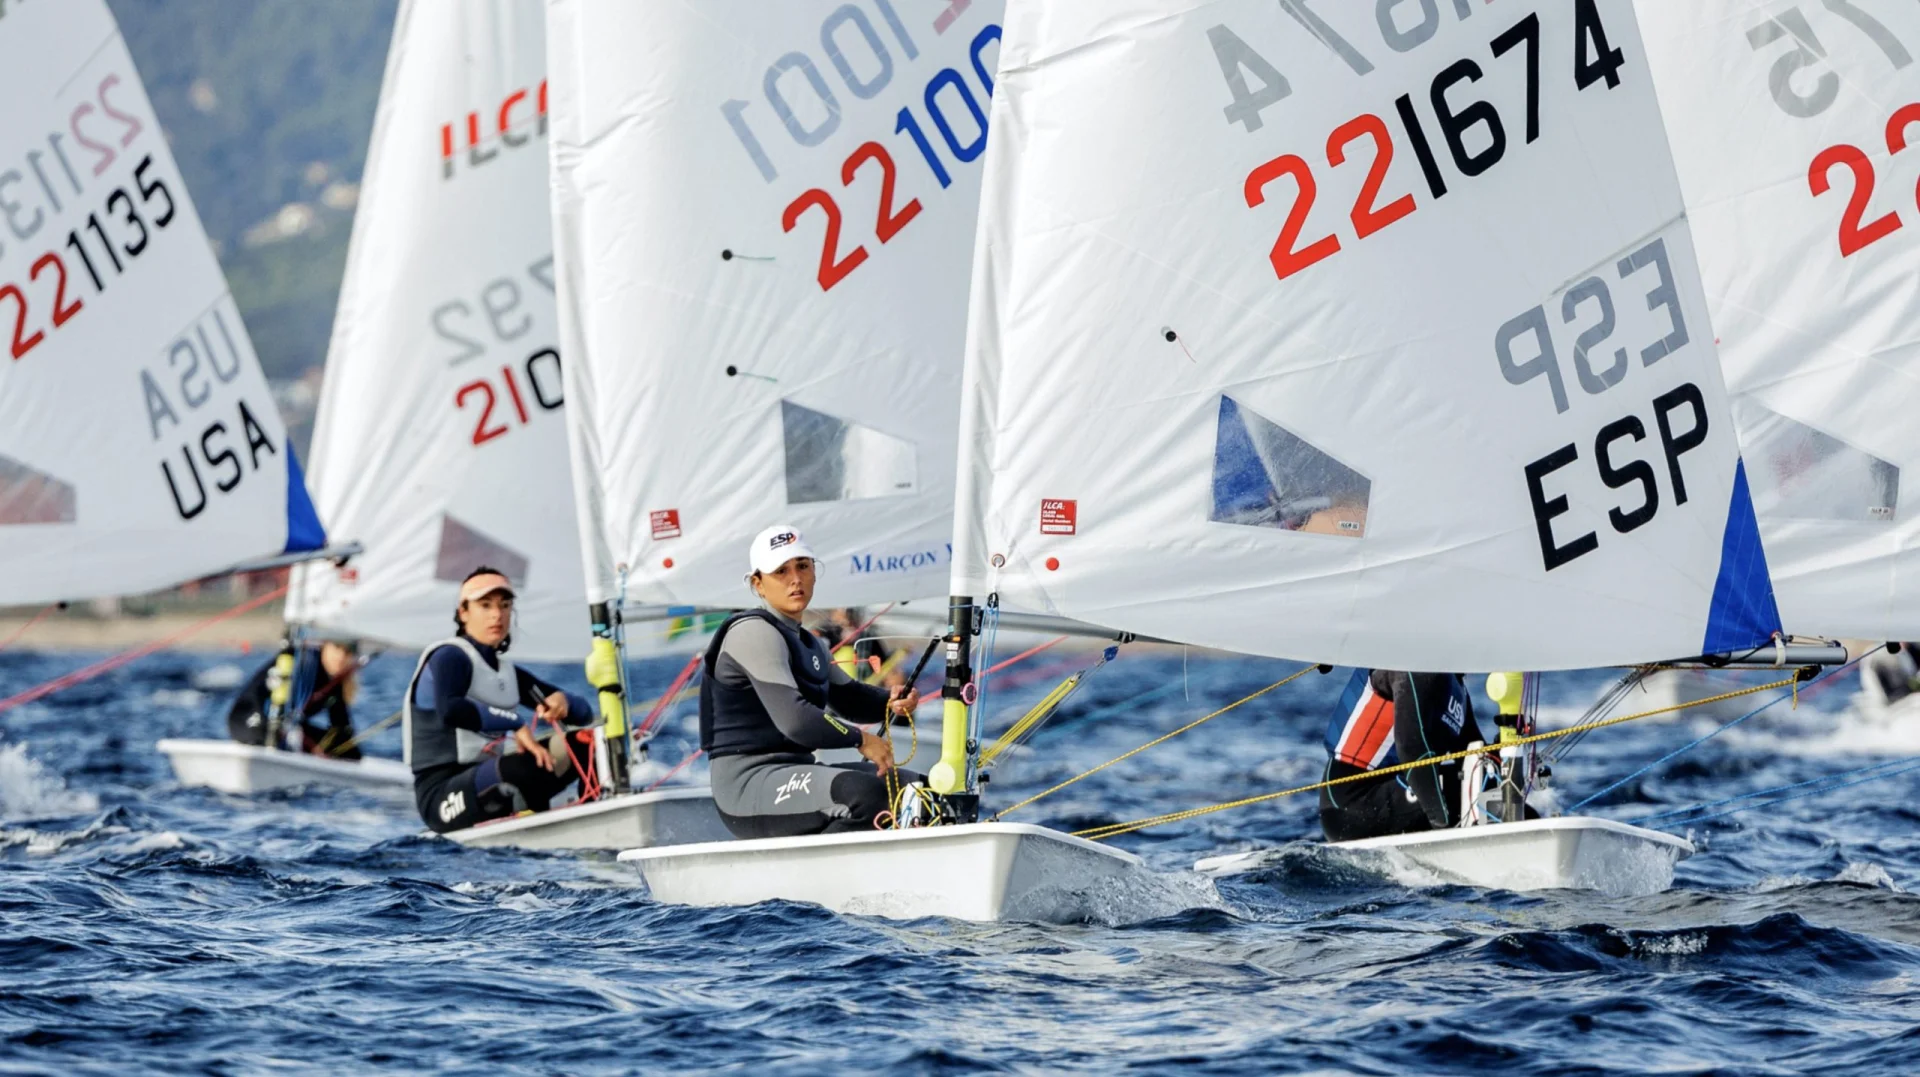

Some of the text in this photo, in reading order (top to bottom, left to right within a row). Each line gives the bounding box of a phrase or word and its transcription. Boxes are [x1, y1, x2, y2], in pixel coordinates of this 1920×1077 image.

[441, 78, 548, 180] ILC
[1244, 0, 1625, 281] 221674
[0, 155, 175, 360] 221135
[160, 400, 276, 520] USA
[1524, 382, 1708, 572] ESP
[770, 532, 795, 547] ESP
[439, 790, 467, 823] Gill
